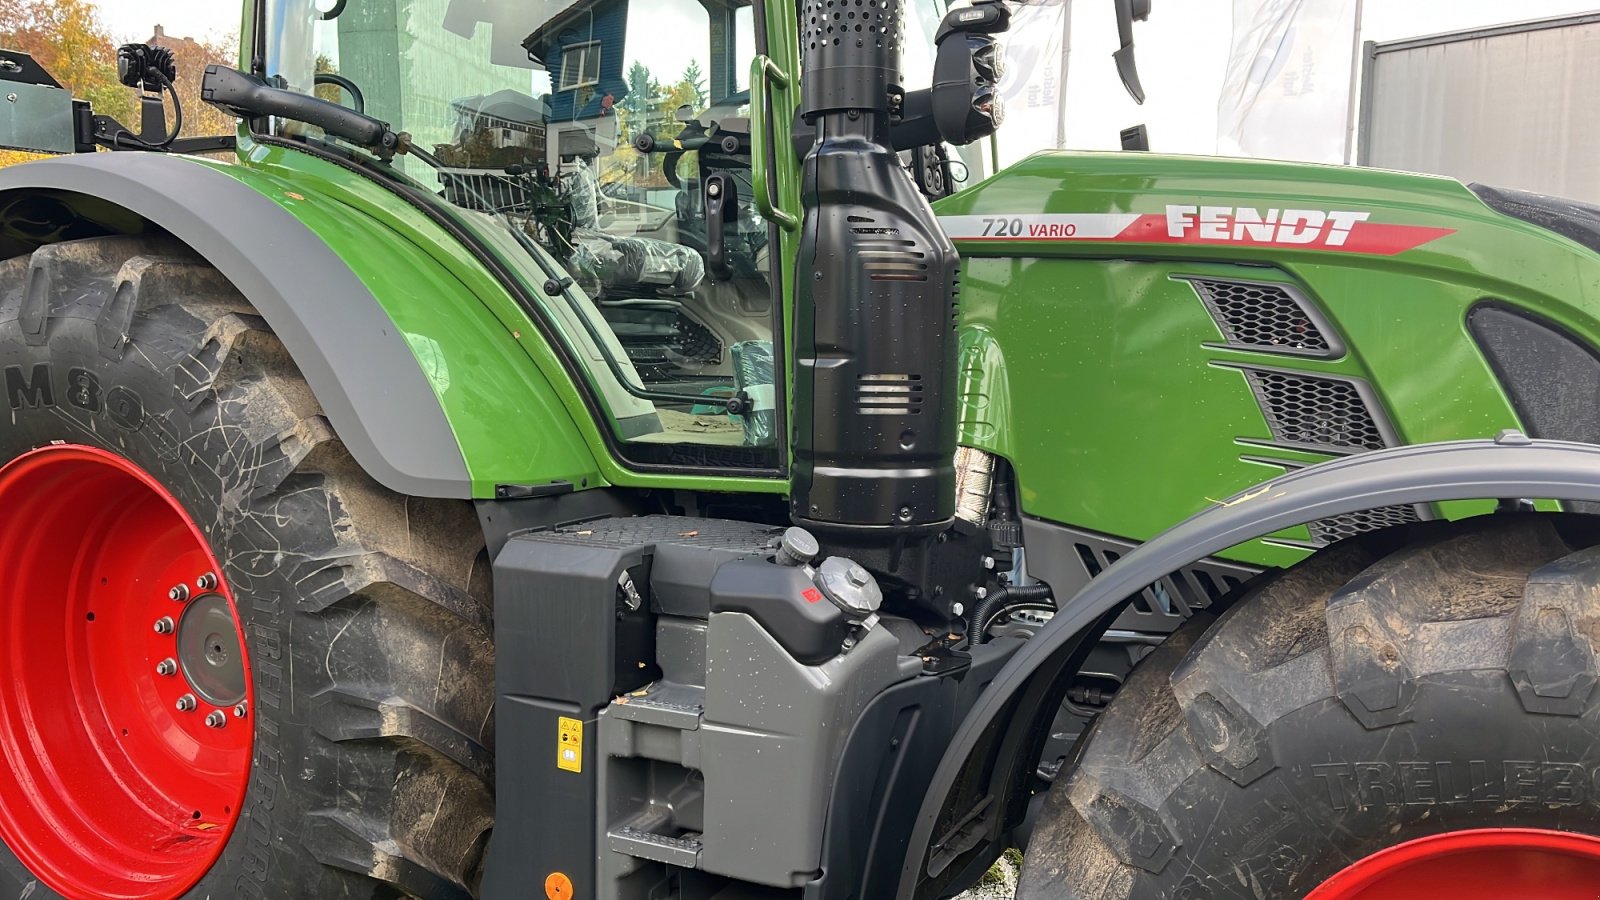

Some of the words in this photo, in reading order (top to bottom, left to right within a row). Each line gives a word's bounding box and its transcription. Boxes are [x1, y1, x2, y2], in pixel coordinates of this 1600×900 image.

[981, 217, 1023, 238] 720
[1028, 222, 1076, 238] VARIO
[1165, 204, 1370, 247] FENDT
[1310, 759, 1600, 811] TRELLEB
